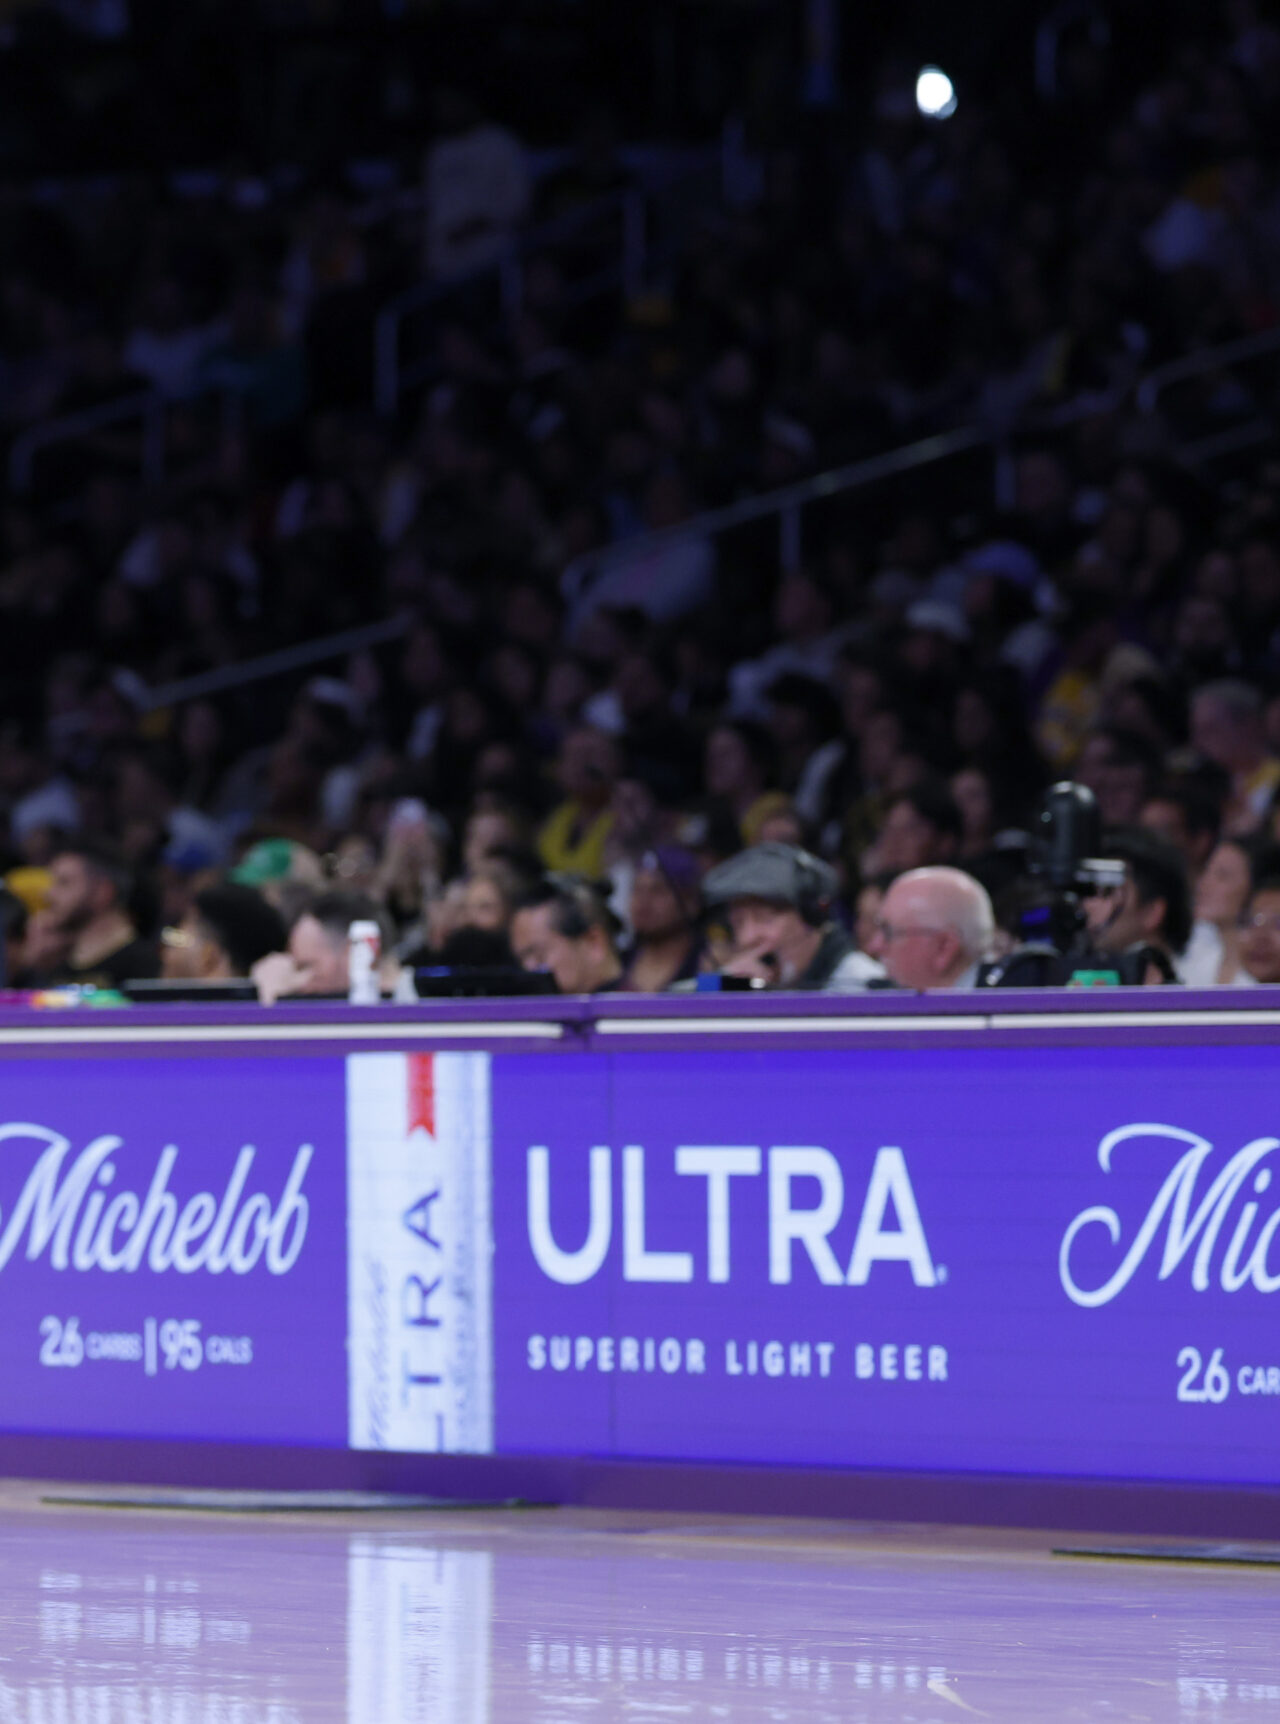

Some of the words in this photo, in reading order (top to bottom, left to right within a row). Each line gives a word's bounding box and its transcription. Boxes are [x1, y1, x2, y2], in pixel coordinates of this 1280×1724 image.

[527, 1145, 940, 1287] ULTRA
[159, 1318, 203, 1371] 95
[527, 1334, 706, 1373] SUPERIOR
[725, 1340, 835, 1378] LIGHT
[855, 1343, 949, 1381] BEER
